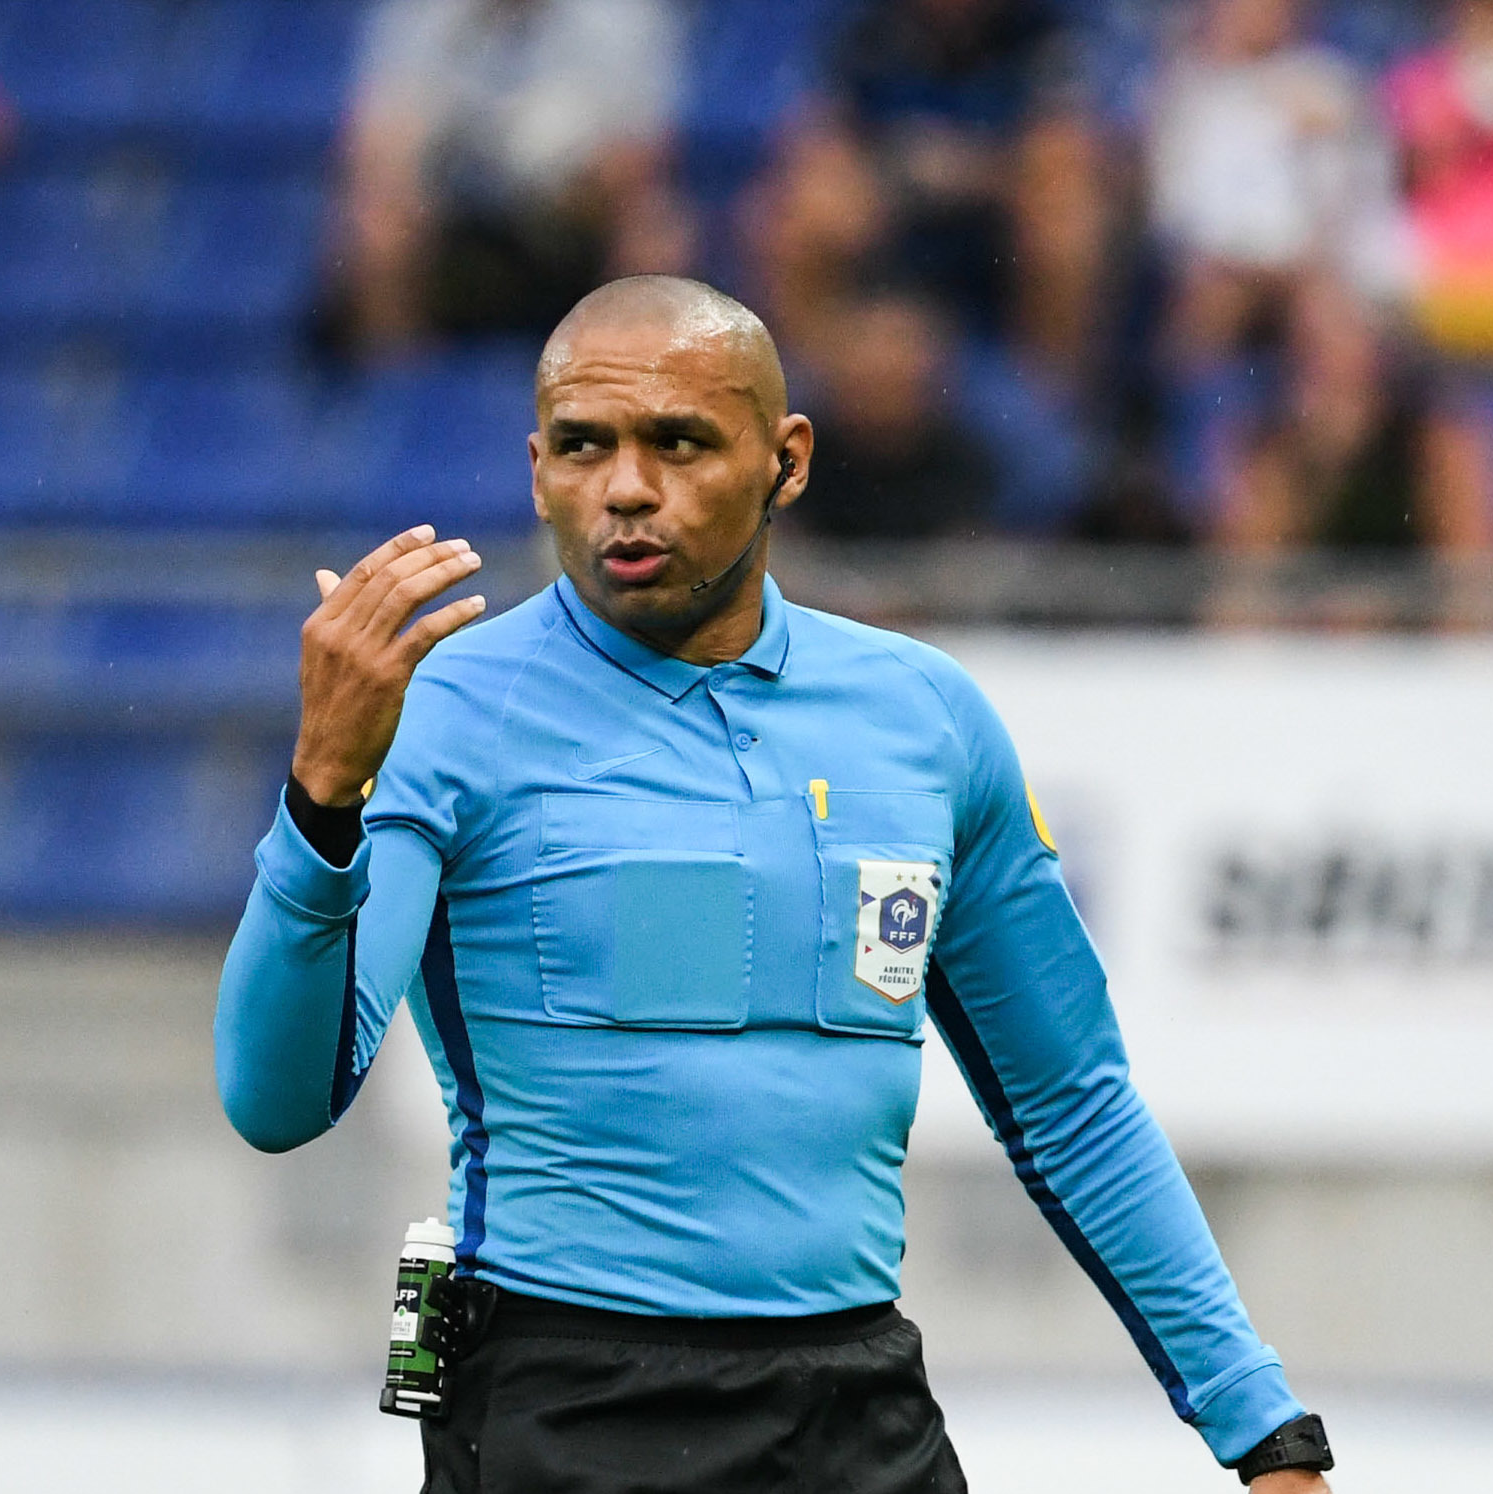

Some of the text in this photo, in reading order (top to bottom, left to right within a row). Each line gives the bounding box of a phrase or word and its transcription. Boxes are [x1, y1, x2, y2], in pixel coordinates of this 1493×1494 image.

[889, 930, 917, 942] FFF
[883, 965, 914, 975] ARBITRE
[878, 974, 910, 985] FÉDÉRAL
